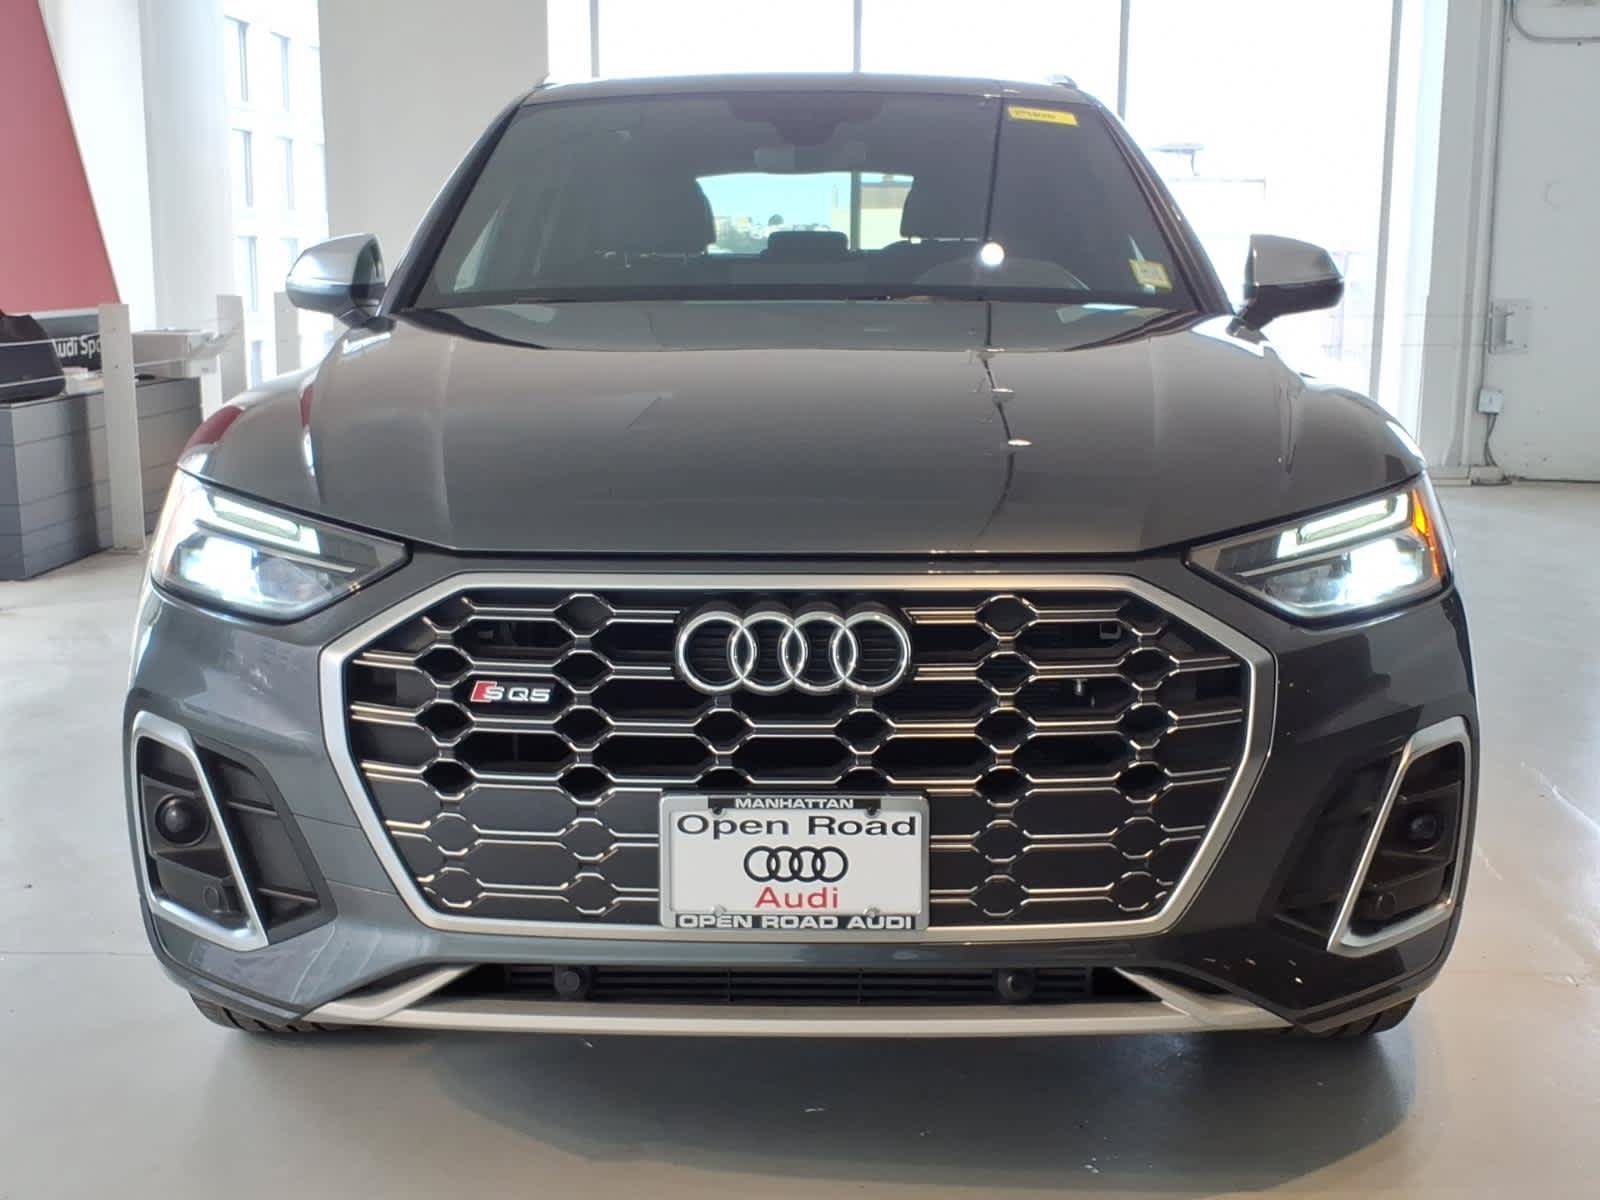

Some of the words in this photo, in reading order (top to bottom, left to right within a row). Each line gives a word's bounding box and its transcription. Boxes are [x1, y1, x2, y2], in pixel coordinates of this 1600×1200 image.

[735, 799, 854, 809] MANHATTAN
[677, 814, 789, 840] Open
[808, 816, 916, 836] Road
[755, 886, 839, 909] Audi
[678, 914, 752, 929] OPEN
[761, 915, 839, 929] ROAD
[846, 915, 912, 929] AUDI
